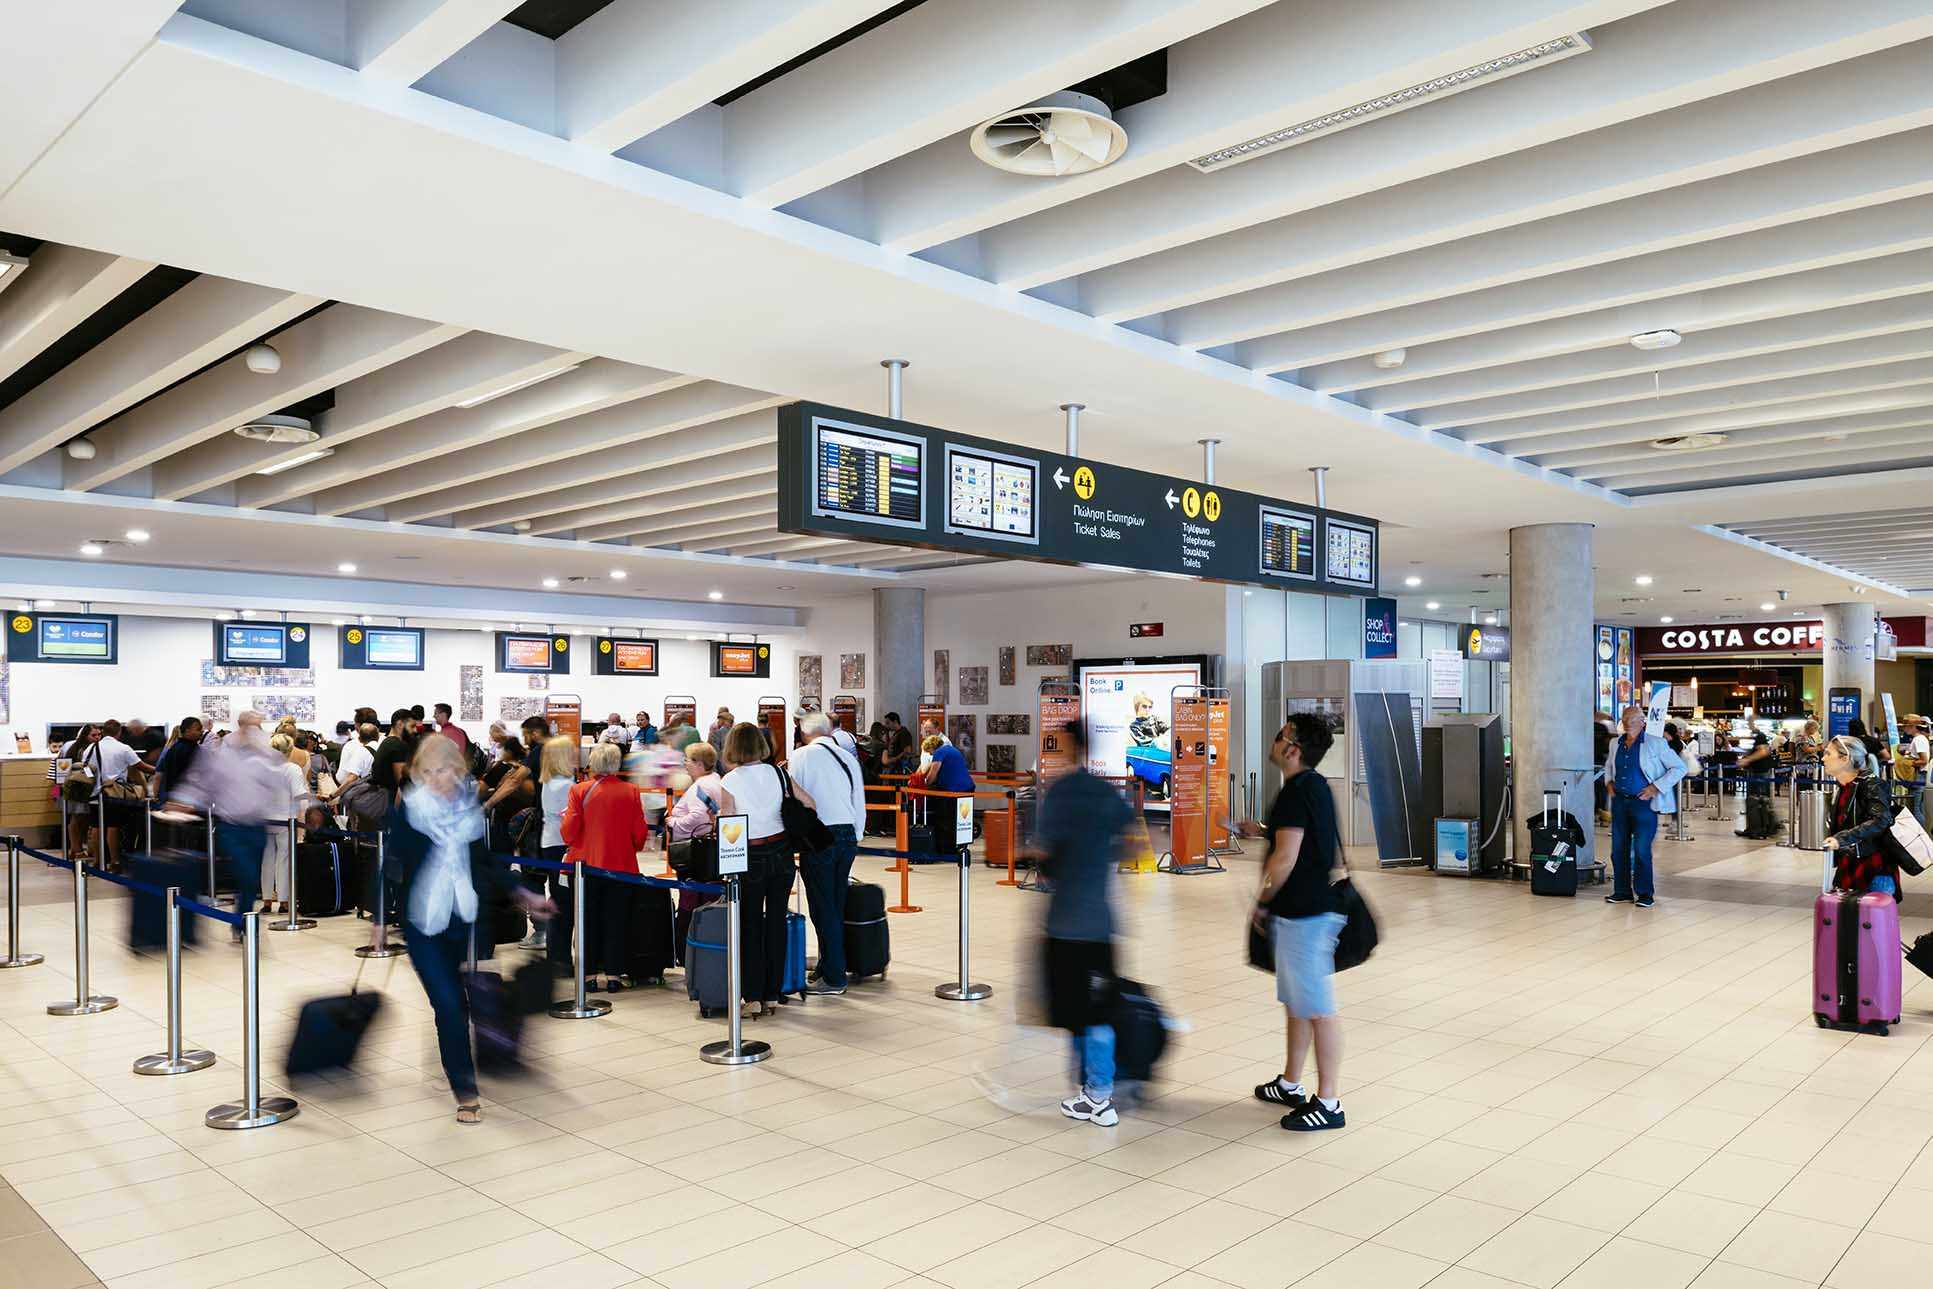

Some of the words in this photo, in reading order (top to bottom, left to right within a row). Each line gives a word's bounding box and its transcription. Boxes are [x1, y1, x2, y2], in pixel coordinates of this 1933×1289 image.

[1073, 522, 1098, 537] Ticket
[1100, 527, 1121, 540] Sales
[1182, 534, 1216, 547] Telephones
[1182, 557, 1201, 569] Toilets
[15, 619, 30, 630] 23
[1366, 618, 1384, 630] SHOP
[348, 632, 361, 641] 25
[1366, 631, 1393, 644] COLLECT
[1661, 628, 1745, 650] COSTA
[1753, 625, 1824, 646] COFF
[1042, 705, 1057, 714] BAG
[1058, 705, 1078, 714] DROP
